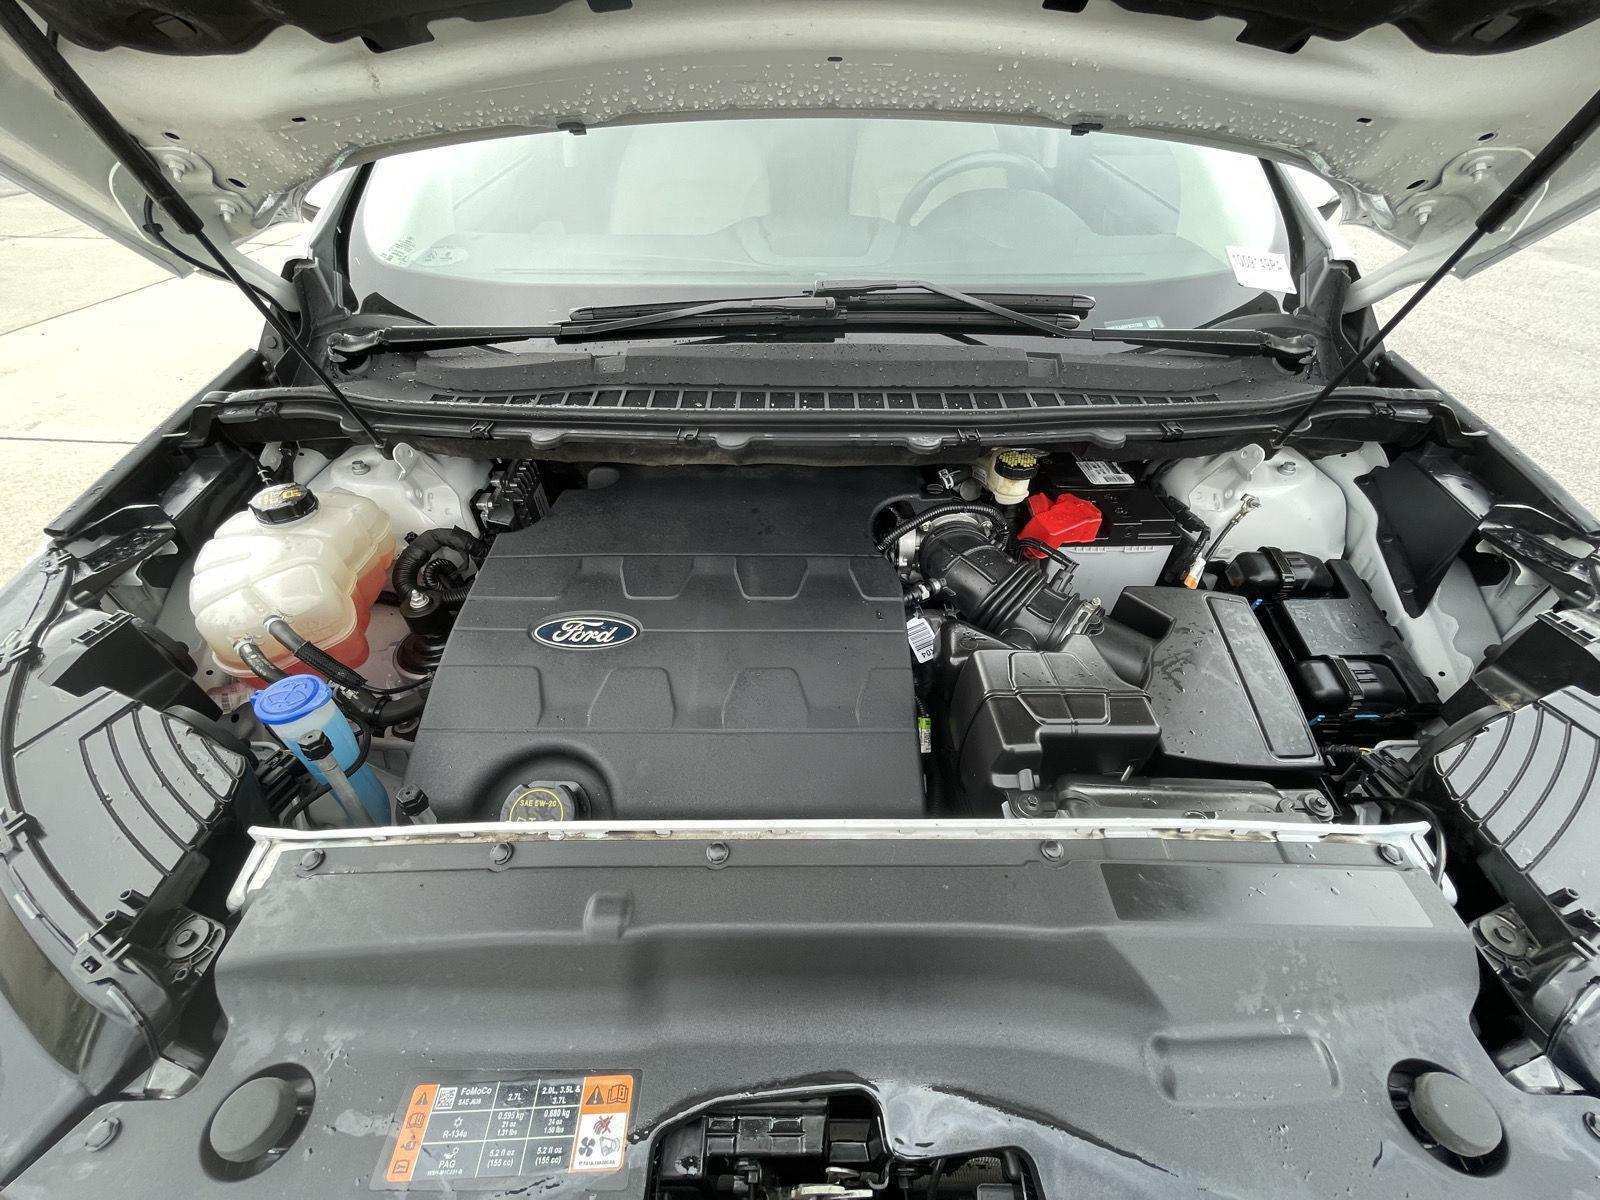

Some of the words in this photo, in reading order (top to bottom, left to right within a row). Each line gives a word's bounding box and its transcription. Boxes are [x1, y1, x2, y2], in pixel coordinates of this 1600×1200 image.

[552, 620, 619, 643] Ford
[461, 1086, 493, 1096] FoMoCo
[542, 1086, 558, 1095] 2.0L,
[560, 1085, 574, 1094] 3.5L
[575, 1085, 581, 1093] &
[507, 1093, 522, 1101] 2.7L
[552, 1096, 567, 1105] 3.7L
[458, 1098, 470, 1106] SAE
[498, 1111, 515, 1120] 0.595
[516, 1111, 525, 1121] kg
[562, 1108, 571, 1119] kg
[442, 1130, 468, 1139] R-134a
[489, 1149, 500, 1157] 5.2
[500, 1148, 506, 1157] fl
[536, 1146, 547, 1155] 5.2
[547, 1146, 554, 1154] fl
[554, 1146, 563, 1154] oz
[439, 1160, 456, 1169] PAG
[487, 1159, 501, 1169] (155
[502, 1158, 514, 1168] cc)
[535, 1156, 550, 1166] (155
[550, 1155, 562, 1165] cc)
